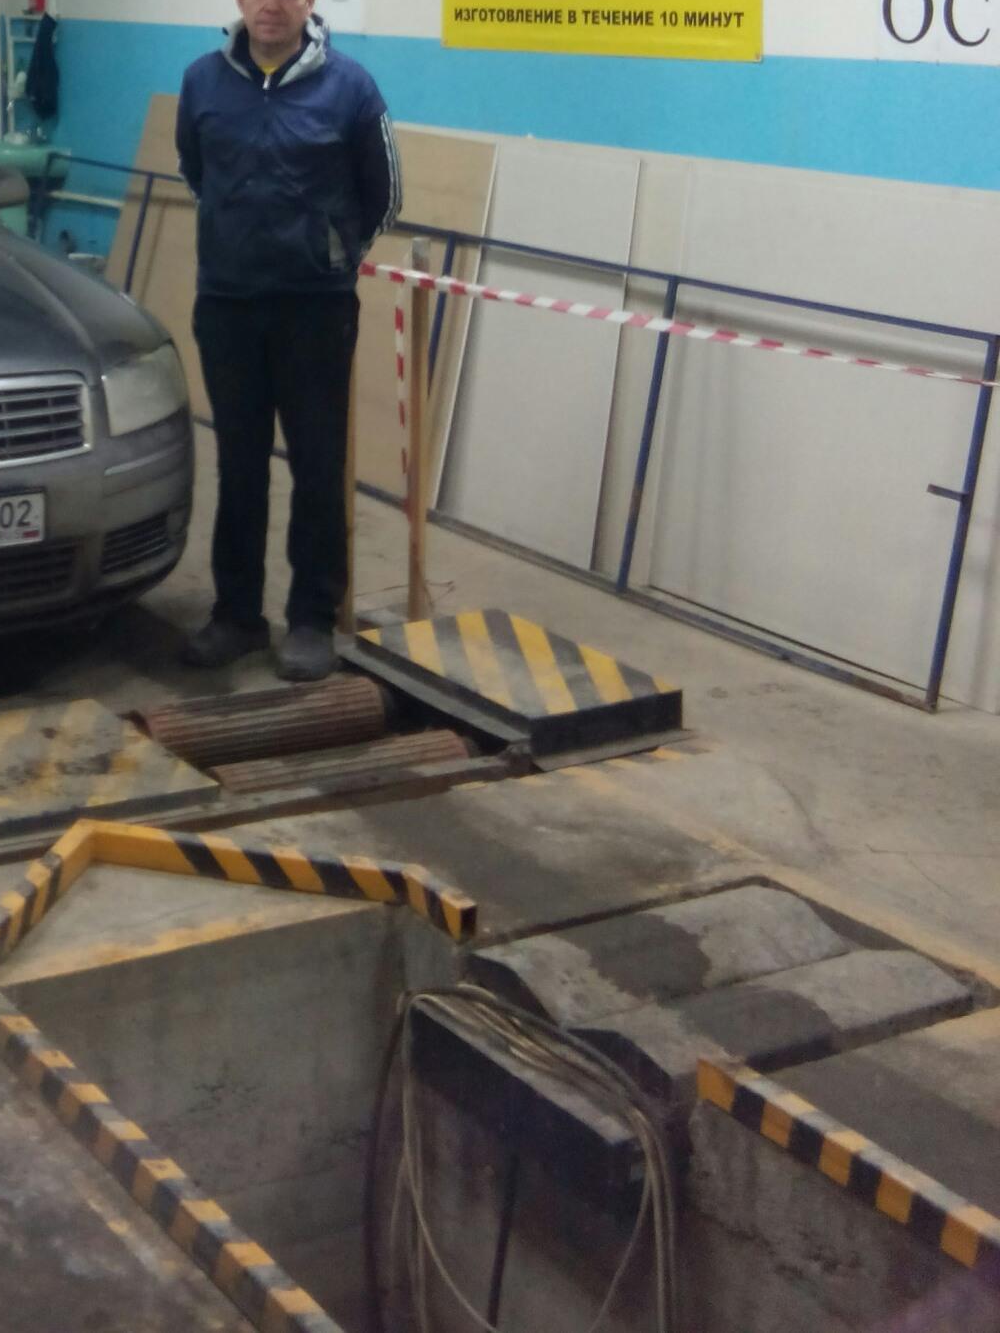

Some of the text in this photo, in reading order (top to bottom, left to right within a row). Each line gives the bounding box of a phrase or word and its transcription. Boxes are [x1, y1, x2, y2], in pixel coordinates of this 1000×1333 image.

[454, 8, 744, 28] ИЗГОТОВЛЕНИЕ В ТЕЧЕНИЕ 10 МИНУТ
